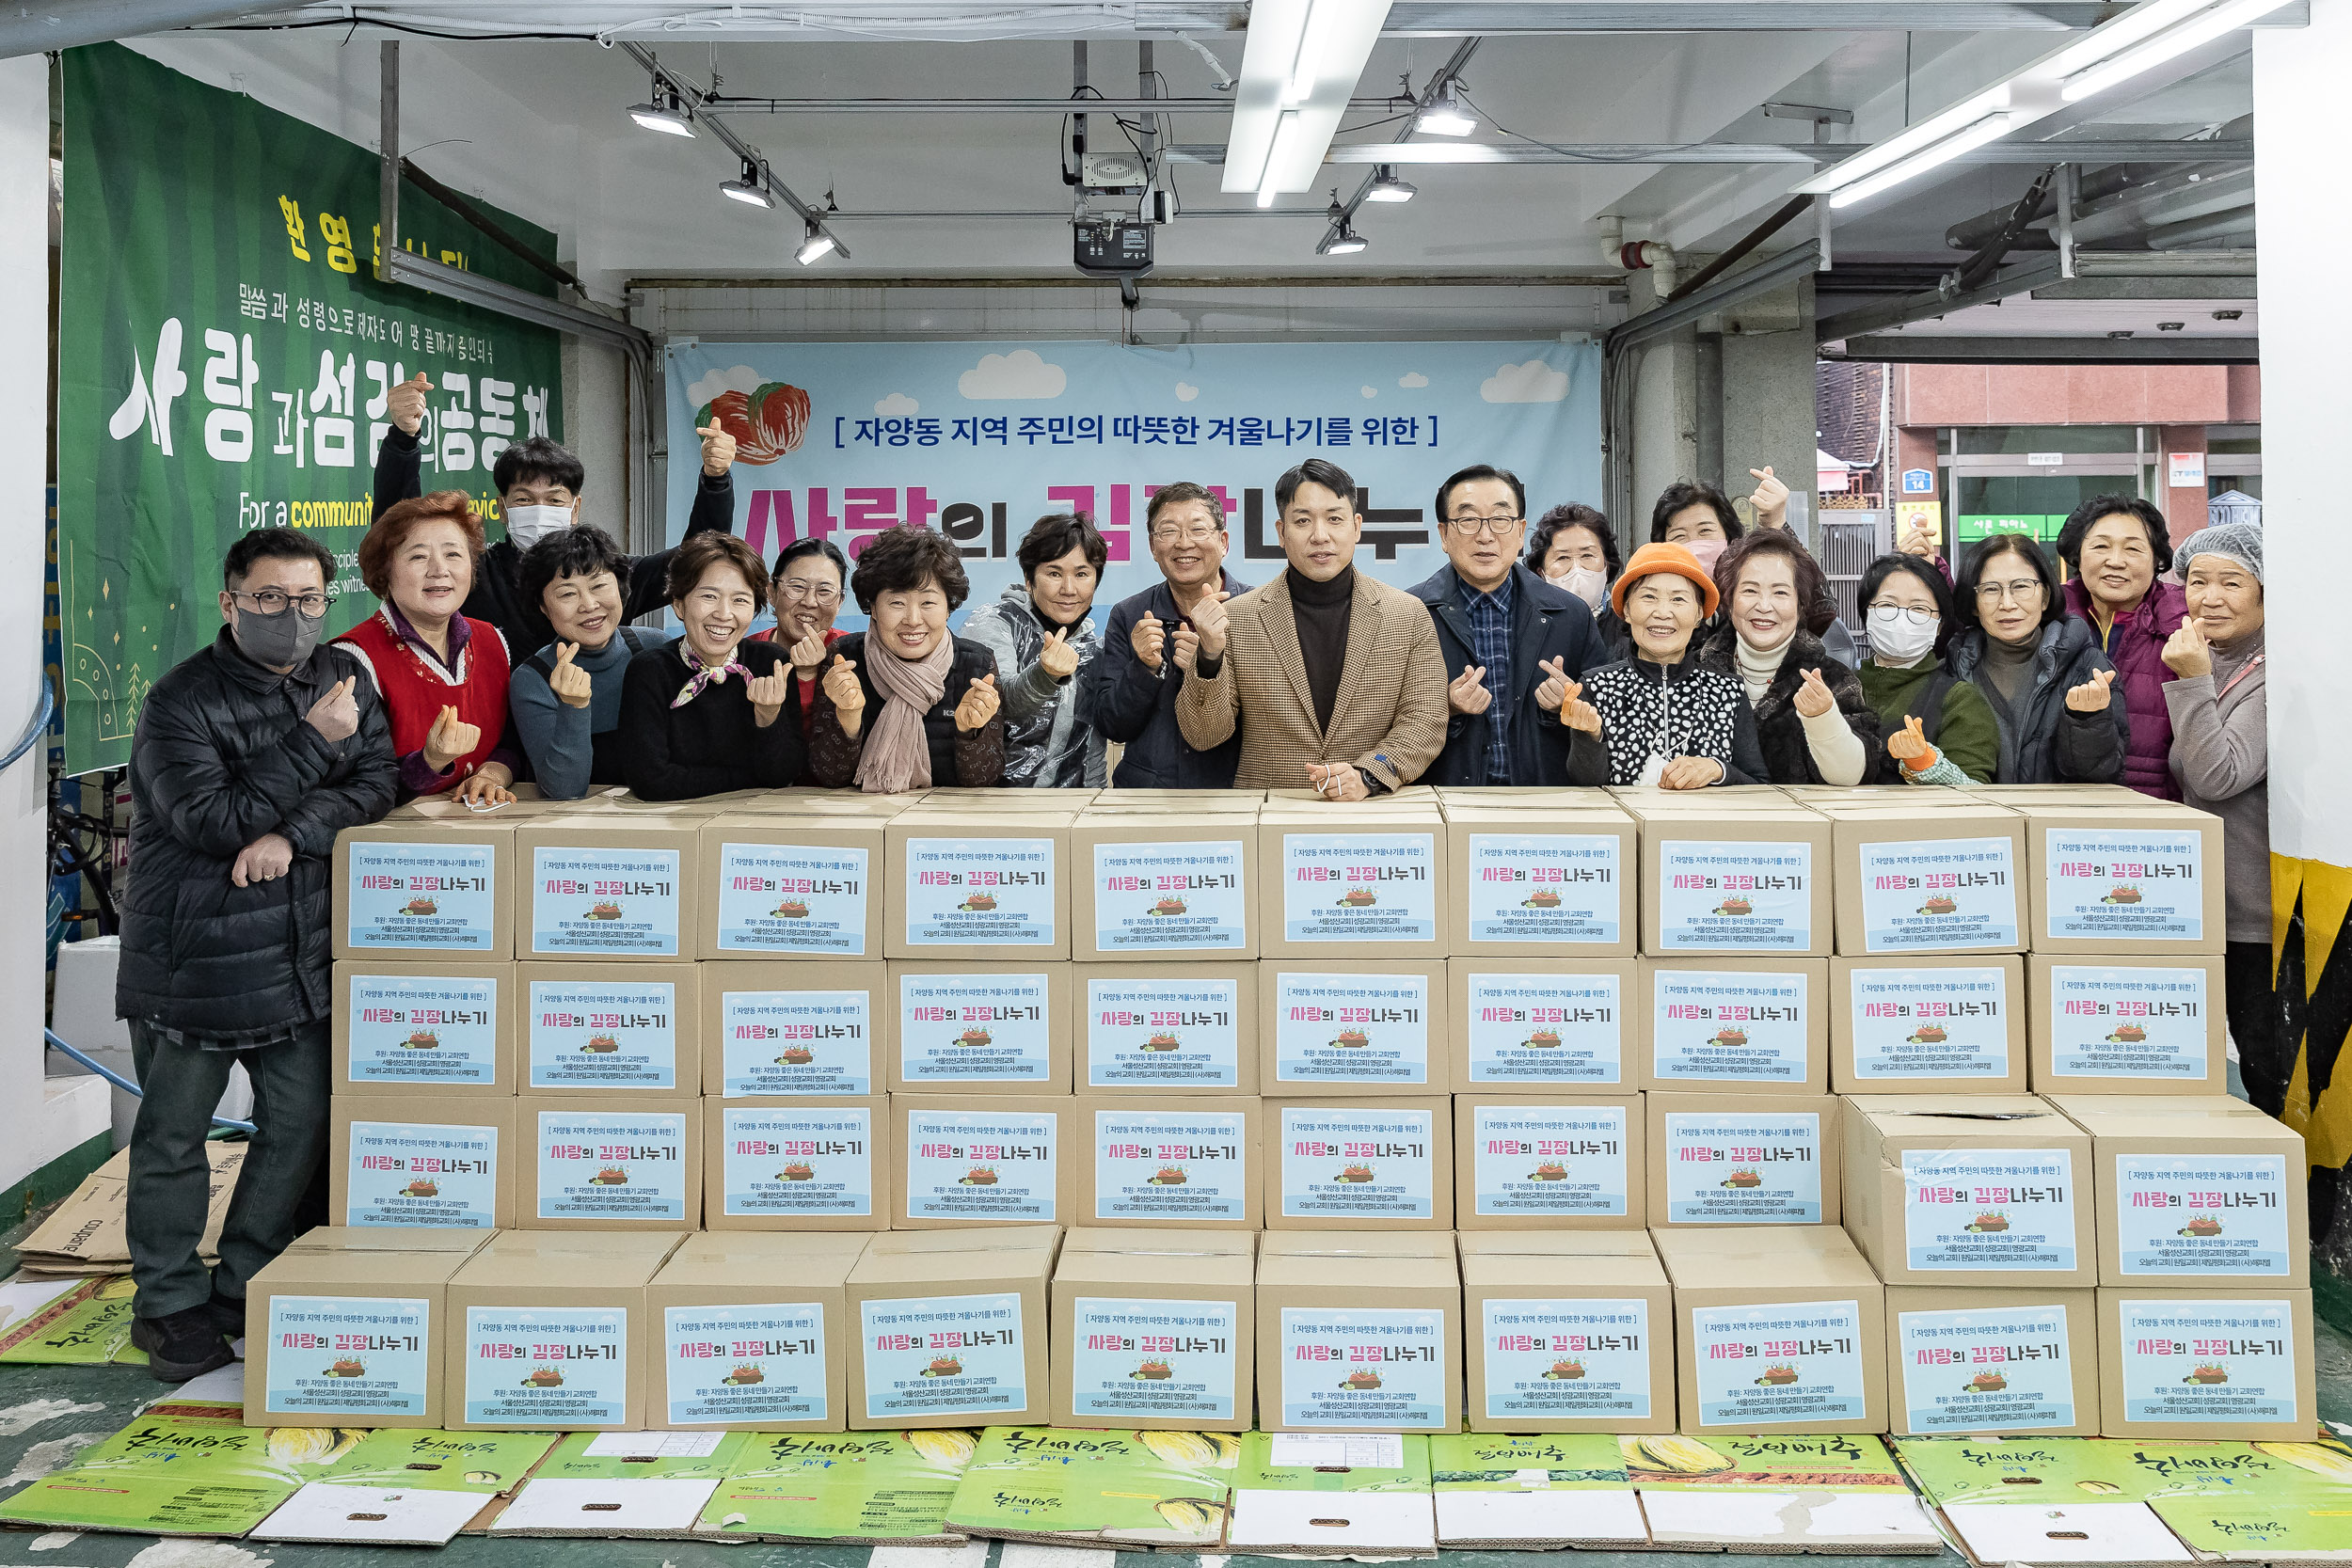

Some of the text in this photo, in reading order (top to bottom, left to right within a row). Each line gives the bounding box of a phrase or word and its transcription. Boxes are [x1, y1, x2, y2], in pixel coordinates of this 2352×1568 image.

[239, 282, 289, 324] 말씀과
[296, 296, 355, 336] 성령으로
[108, 317, 310, 468] 사랑과
[853, 417, 943, 447] 자양동
[950, 416, 1008, 446] 지역
[1017, 415, 1103, 445] 주민의
[1113, 415, 1200, 446] 따뜻한
[1208, 416, 1353, 447] 겨울나기를
[1360, 416, 1420, 446] 위한
[1912, 480, 1925, 490] 14
[239, 491, 271, 530] For
[276, 502, 288, 528] a
[291, 491, 373, 529] communit
[735, 858, 754, 866] 자양동
[769, 859, 787, 867] 주민의
[788, 860, 807, 868] 따뜻한
[809, 861, 839, 869] 겨울나기를
[841, 862, 853, 870] 위한
[2060, 863, 2192, 878] 사랑의 김장나누기
[919, 871, 1044, 885] 사랑의 김장나누기
[1297, 866, 1424, 881] 사랑의 김장나누기
[1483, 867, 1610, 882] 사랑의 김장나누기
[1875, 871, 2004, 890] 사랑의 김장나누기
[361, 875, 485, 891] 사랑의 김장나누기
[546, 879, 670, 895] 사랑의 김장나누기
[733, 876, 858, 895] 사랑의 김장나누기
[1108, 874, 1234, 891] 사랑의 김장나누기
[1674, 875, 1801, 890] 사랑의 김장나누기
[362, 1008, 486, 1024] 사랑의 김장나누기
[914, 1006, 1039, 1021] 사랑의 김장나누기
[1290, 1006, 1418, 1022] 사랑의 김장나누기
[1482, 1007, 1610, 1022] 사랑의 김장나누기
[1668, 1005, 1797, 1022] 사랑의 김장나누기
[1866, 1001, 1995, 1017] 사랑의 김장나누기
[2065, 1000, 2197, 1017] 사랑의 김장나누기
[542, 1013, 665, 1028] 사랑의 김장나누기
[1101, 1011, 1228, 1025] 사랑의 김장나누기
[736, 1024, 860, 1038] 사랑의 김장나누기
[550, 1145, 675, 1160] 사랑의 김장나누기
[737, 1141, 861, 1155] 사랑의 김장나누기
[920, 1144, 1047, 1160] 사랑의 김장나누기
[1108, 1144, 1235, 1160] 사랑의 김장나누기
[1295, 1141, 1422, 1158] 사랑의 김장나누기
[1487, 1140, 1616, 1154] 사랑의 김장나누기
[1680, 1147, 1810, 1162] 사랑의 김장나누기
[361, 1155, 487, 1174] 사랑의 김장나누기
[2134, 1171, 2269, 1180] 자양동 지역 주민의 따뜻한 겨울나기를 위한
[1919, 1187, 2062, 1203] 사랑의 김장나누기
[2133, 1192, 2276, 1208] 사랑의 김장나누기
[2166, 1239, 2184, 1247] 자양동
[2200, 1239, 2212, 1247] 동네
[285, 1313, 413, 1324] 자양동 지역 주민의 따뜻한 겨울나기를 위한
[282, 1333, 418, 1351] 사랑의 김장나누기
[680, 1338, 814, 1358] 사랑의 김장나누기
[877, 1329, 1012, 1351] 사랑의 김장나누기
[1088, 1335, 1225, 1353] 사랑의 김장나누기
[1499, 1335, 1638, 1351] 사랑의 김장나누기
[2137, 1338, 2282, 1355] 사랑의 김장나누기
[480, 1343, 616, 1359] 사랑의 김장나누기
[1295, 1345, 1434, 1361] 사랑의 김장나누기
[1709, 1338, 1851, 1359] 사랑의 김장나누기
[1916, 1343, 2058, 1365] 사랑의 김장나누기
